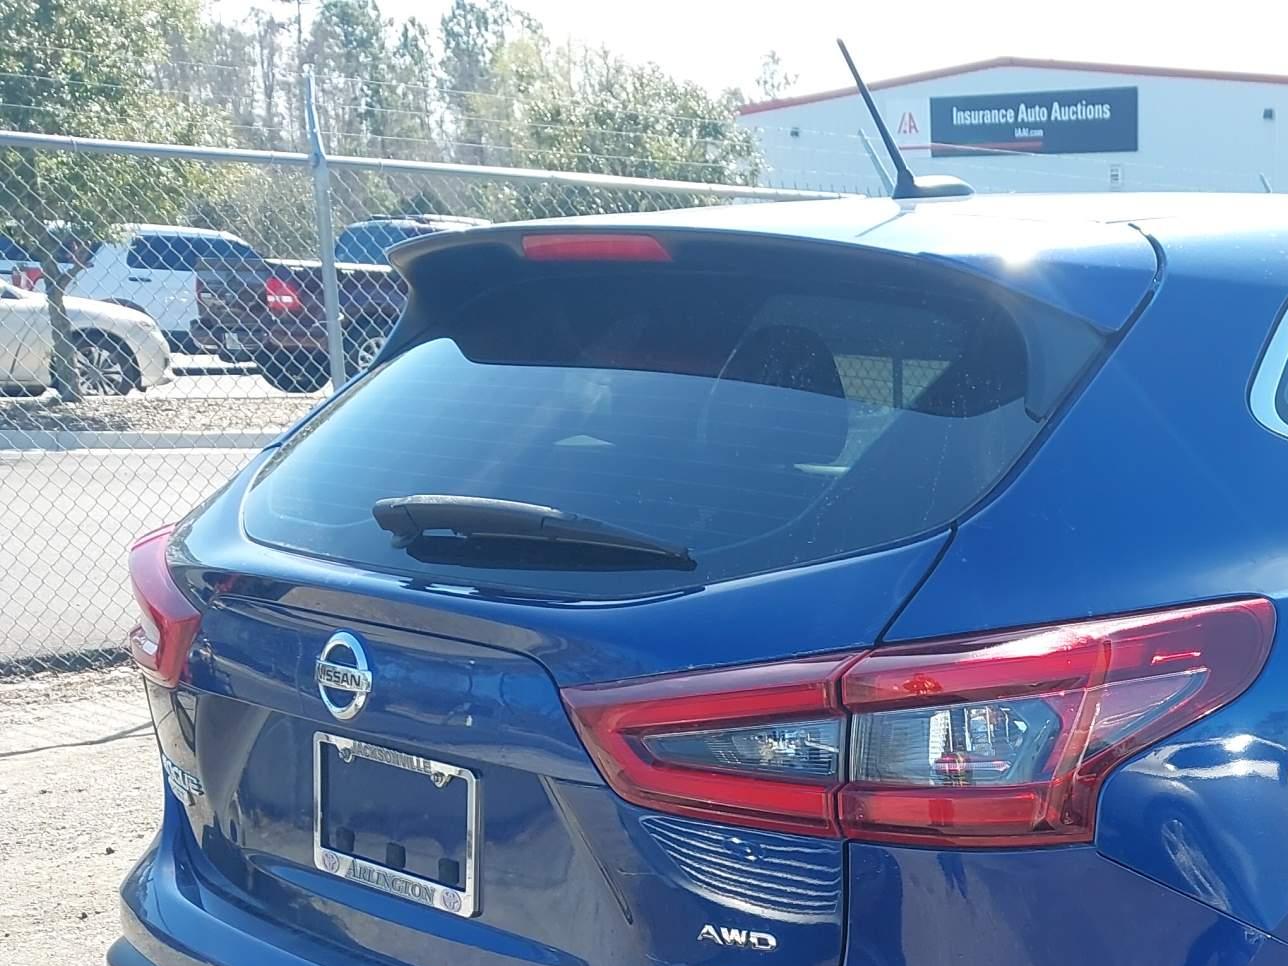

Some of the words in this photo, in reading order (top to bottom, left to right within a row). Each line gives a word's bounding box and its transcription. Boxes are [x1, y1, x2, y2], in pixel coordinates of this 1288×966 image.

[953, 106, 1015, 126] Insurance
[1017, 103, 1048, 122] Auto
[1051, 100, 1111, 121] Auctions
[318, 662, 362, 688] NISSAN
[345, 858, 436, 906] ARLINGTON
[697, 924, 778, 951] AWD
